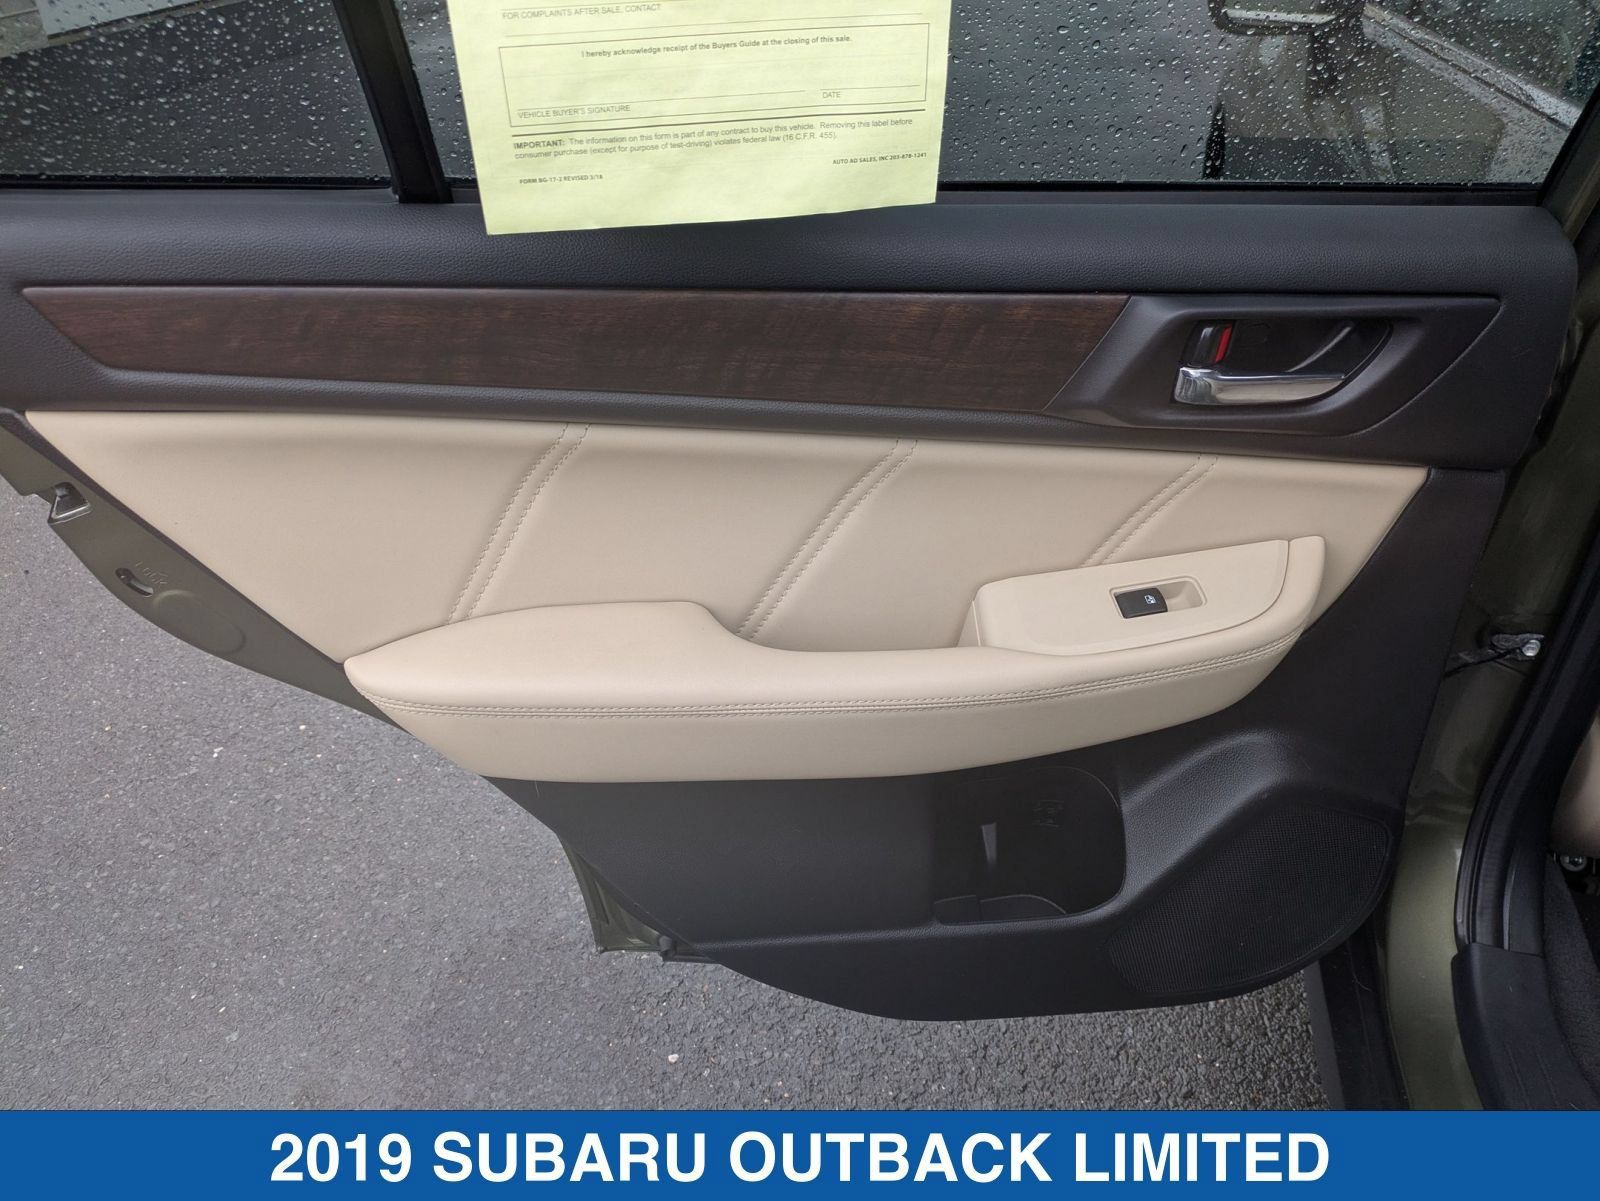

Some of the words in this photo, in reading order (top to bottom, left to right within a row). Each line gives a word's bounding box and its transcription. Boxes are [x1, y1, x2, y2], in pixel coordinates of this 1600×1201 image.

[502, 11, 519, 19] FOR
[521, 9, 572, 18] COMPLAINTS
[574, 7, 600, 15] AFTER
[586, 49, 611, 58] hereby
[613, 46, 661, 56] acknowledge
[663, 44, 687, 53] receipt
[712, 41, 737, 49] Buyers
[771, 37, 782, 45] the
[784, 35, 809, 45] closing
[518, 109, 551, 118] VEHICLE
[552, 107, 586, 116] BUYER'S
[588, 104, 631, 113] SIGNATURE
[513, 139, 565, 149] IMPORTANT:
[569, 137, 584, 145] The
[586, 135, 627, 144] information
[654, 131, 671, 139] form
[681, 130, 695, 138] part
[706, 129, 719, 137] any
[721, 126, 749, 135] contract
[760, 125, 773, 134] buy
[789, 122, 814, 130] vehicle.
[820, 119, 856, 130] Removing
[515, 150, 552, 158] consumer
[554, 148, 588, 157] purchase
[590, 146, 617, 155] (except
[630, 143, 659, 152] purpose
[670, 139, 712, 148] test-driving)
[714, 136, 741, 145] violates
[743, 134, 767, 142] federal
[783, 133, 793, 141] (16
[795, 131, 817, 139] C.F.R.
[819, 130, 836, 139] 455).
